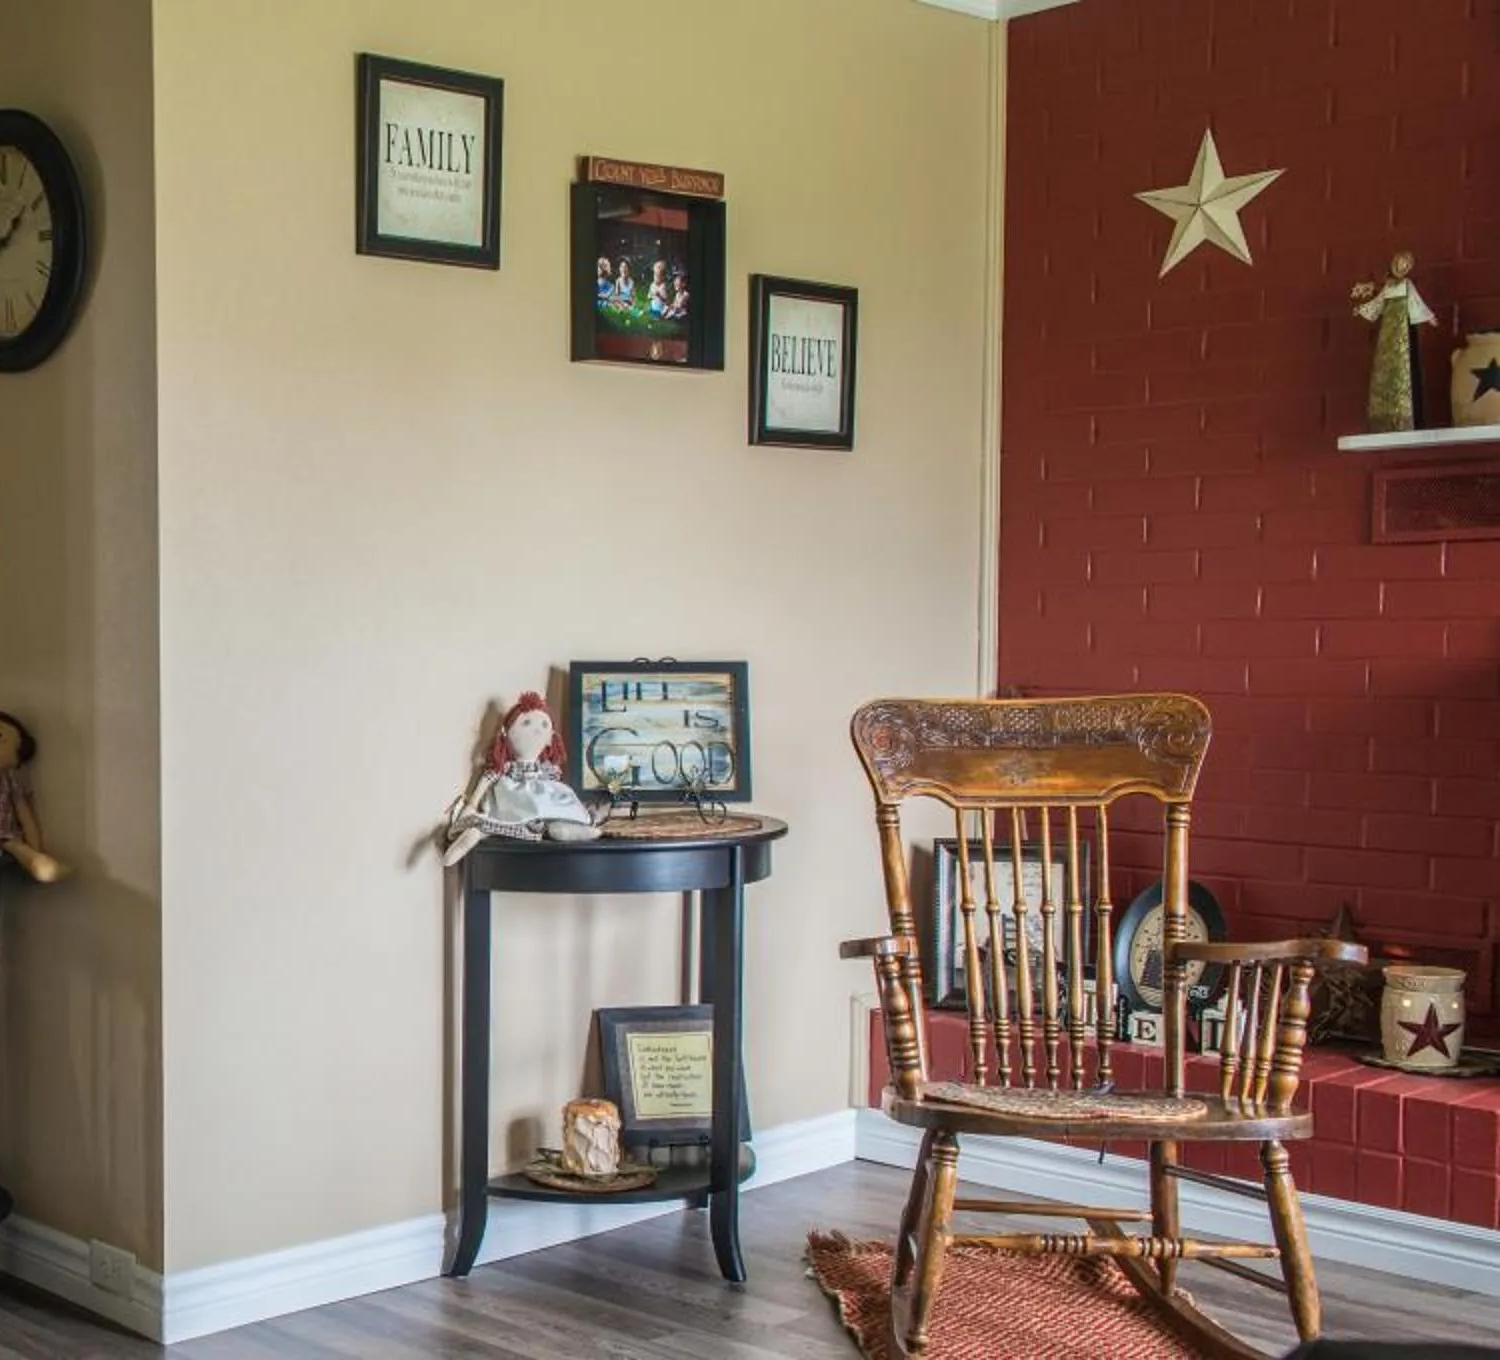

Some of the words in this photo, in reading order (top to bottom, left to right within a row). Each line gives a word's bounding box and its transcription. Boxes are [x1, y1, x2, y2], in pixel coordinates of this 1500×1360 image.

[385, 123, 475, 174] FAMILY
[772, 334, 836, 377] BELIEVE
[683, 709, 720, 729] IS
[586, 726, 736, 786] GOOD
